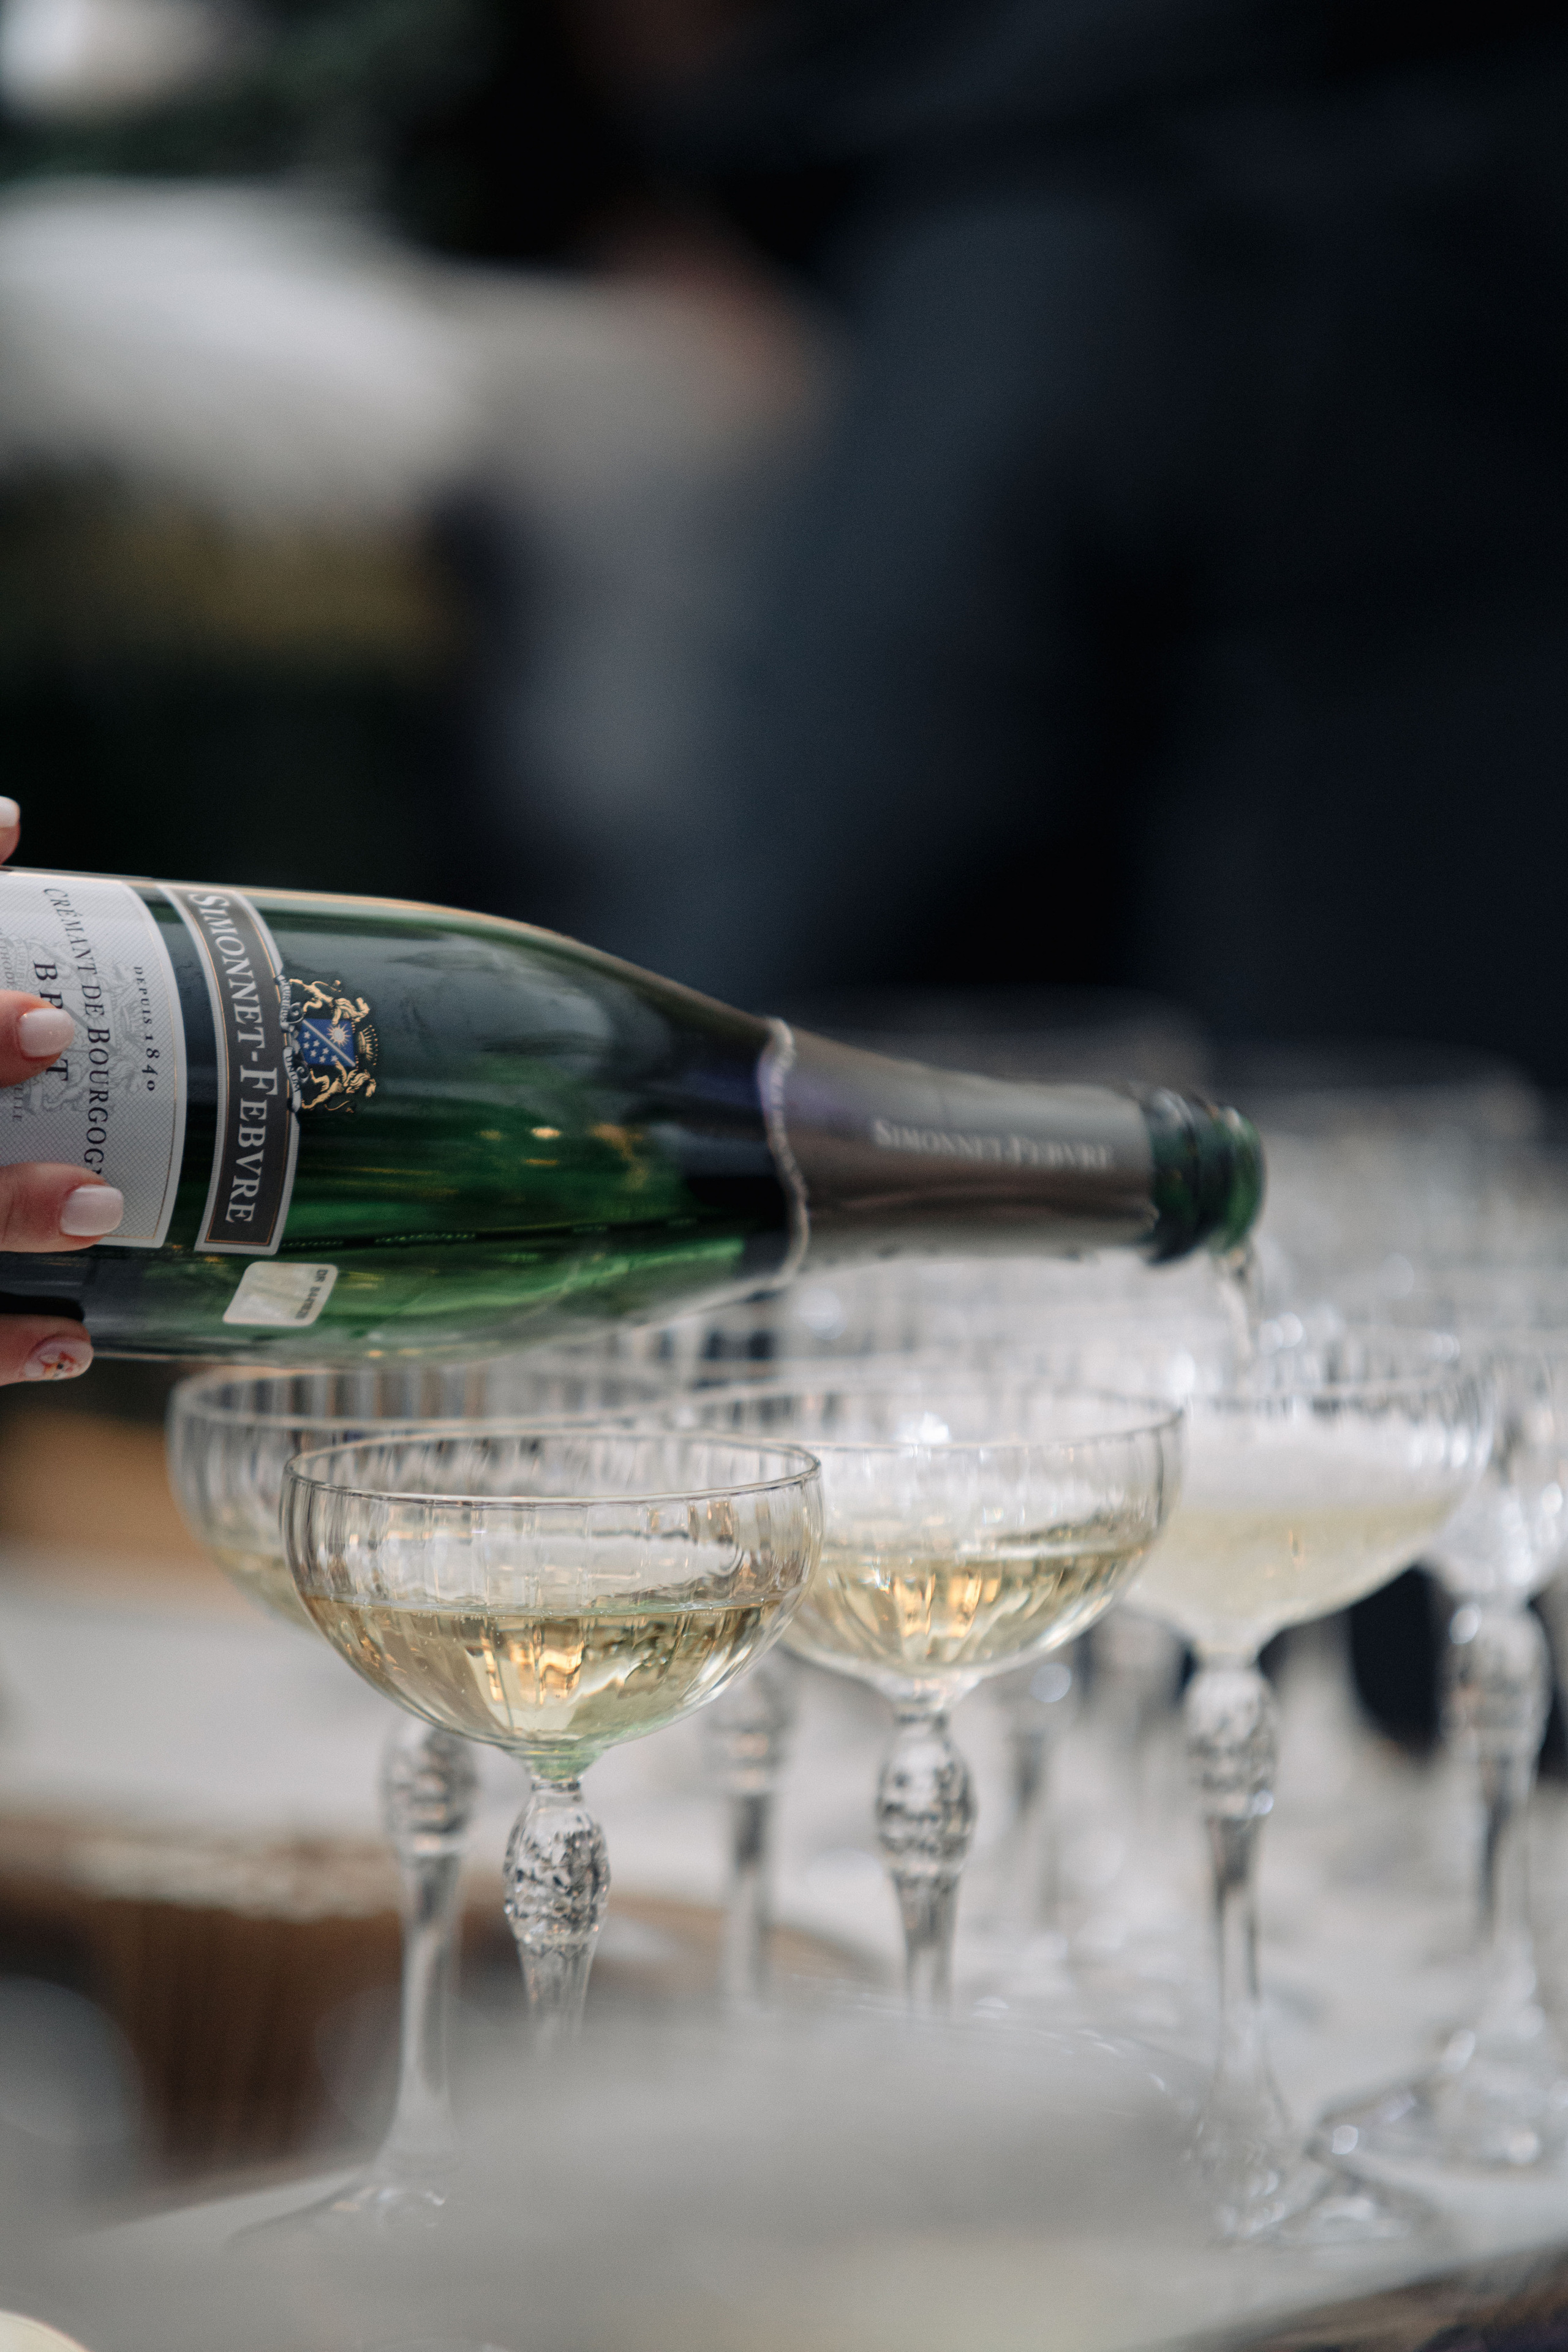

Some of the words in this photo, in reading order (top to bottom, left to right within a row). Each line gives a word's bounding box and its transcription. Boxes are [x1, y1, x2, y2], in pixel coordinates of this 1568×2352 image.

[43, 888, 98, 975] CRÉMANT
[32, 960, 69, 1082] BRT
[81, 983, 105, 1016] DE
[133, 966, 153, 1025] DEPUIS
[141, 1033, 160, 1091] 1840
[188, 894, 279, 1223] SIMONNET-FEBVRE
[285, 1055, 300, 1093] UNUM
[83, 1025, 111, 1175] BOURGOG
